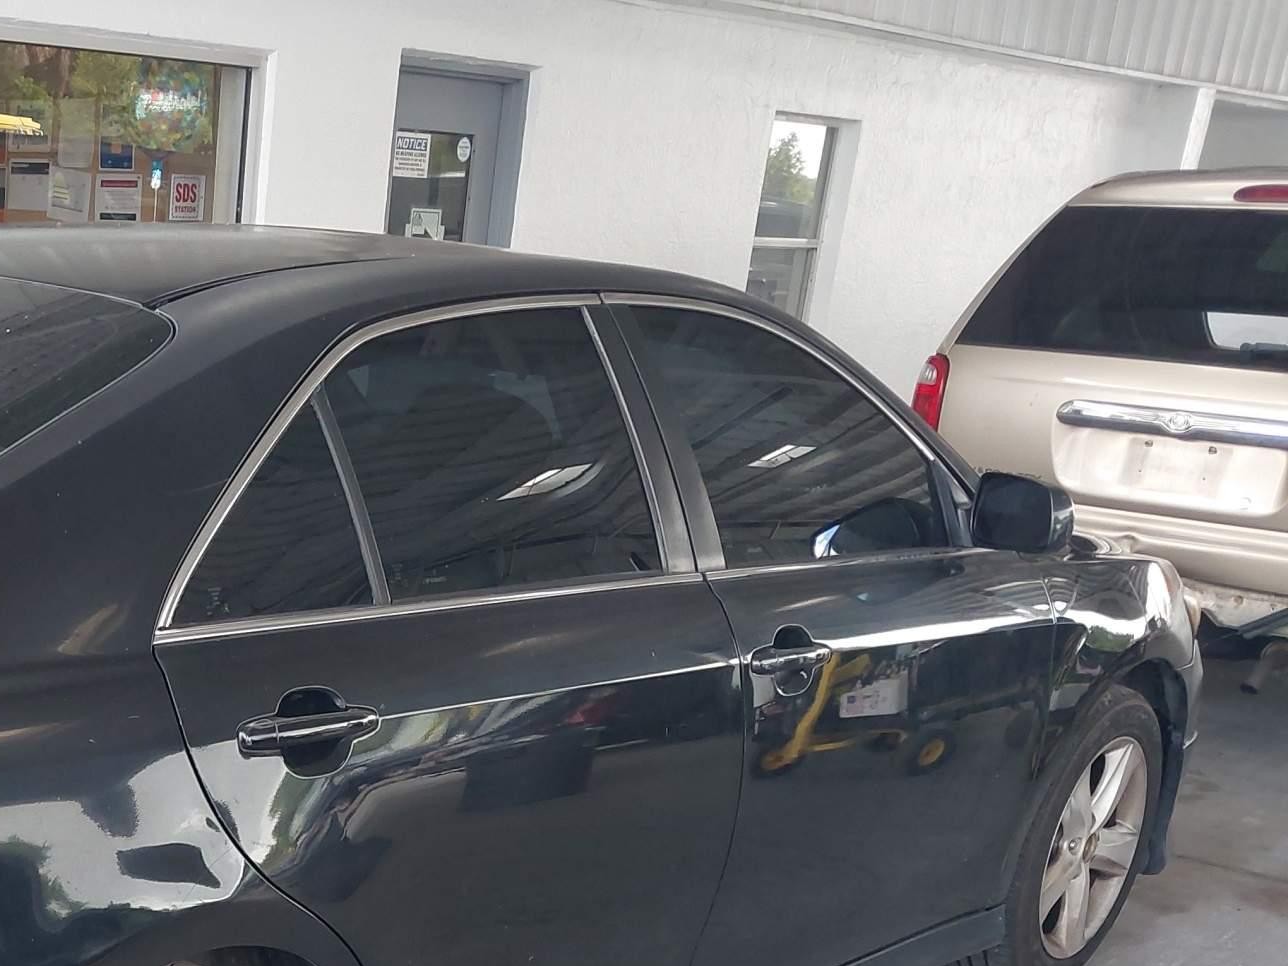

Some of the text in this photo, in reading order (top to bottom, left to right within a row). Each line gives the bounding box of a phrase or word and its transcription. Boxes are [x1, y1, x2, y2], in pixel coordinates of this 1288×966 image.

[397, 137, 427, 150] NOTICE
[175, 183, 197, 203] SDS
[174, 205, 196, 213] STATION
